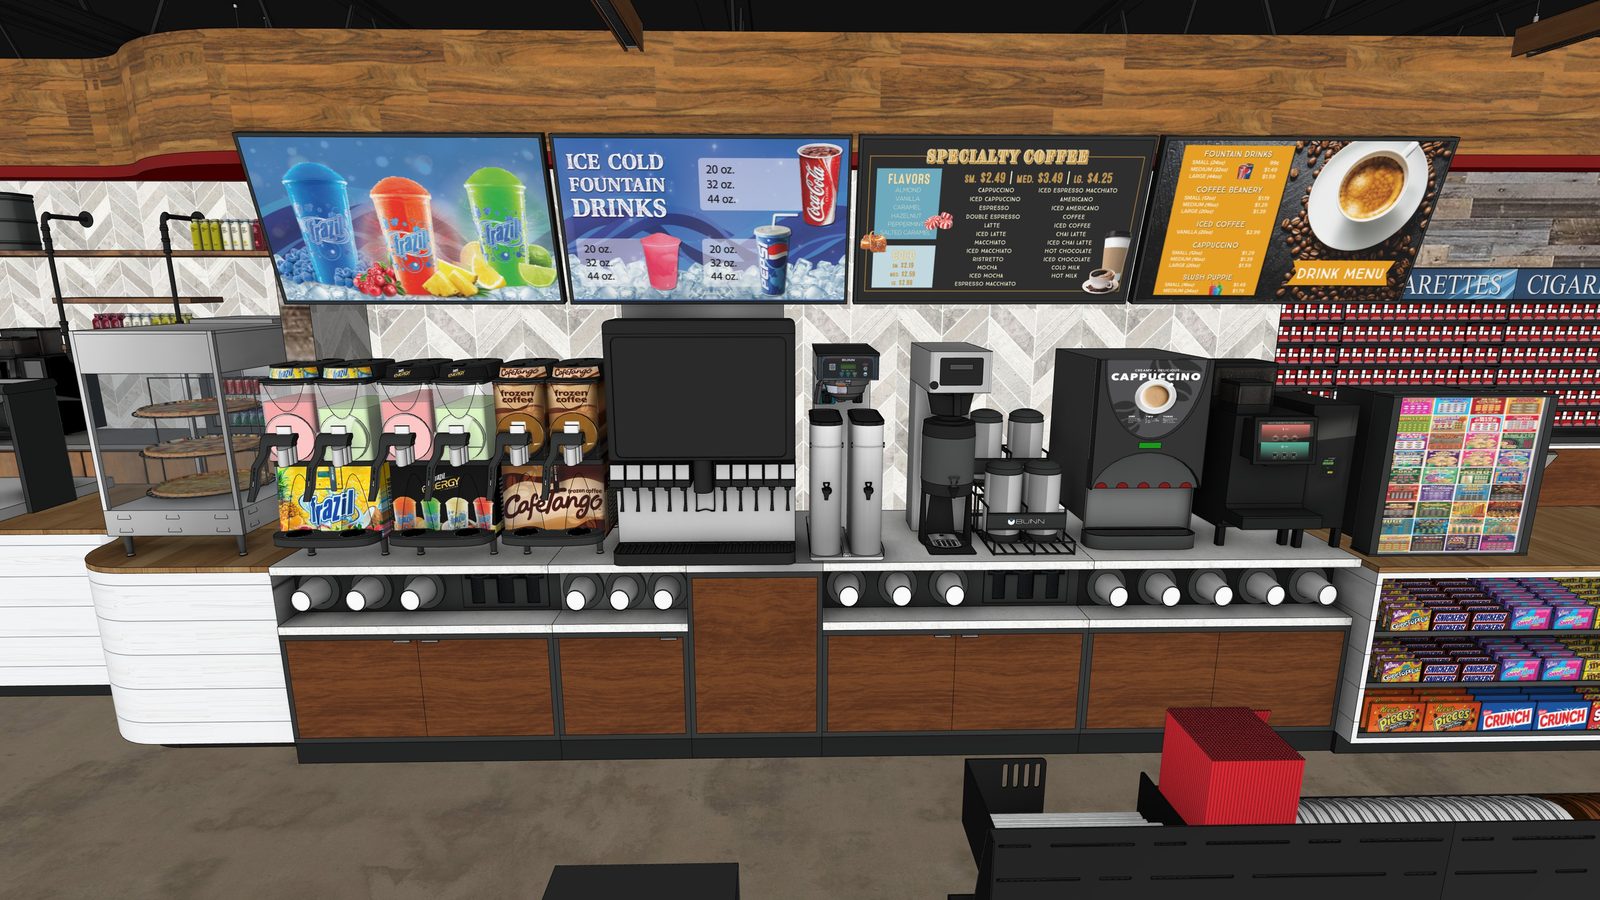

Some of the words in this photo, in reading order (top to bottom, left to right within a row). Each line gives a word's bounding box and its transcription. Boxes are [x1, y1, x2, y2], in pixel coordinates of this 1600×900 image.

[926, 148, 1021, 165] SPECIALTY
[1023, 149, 1090, 165] COFFEE
[566, 153, 601, 170] ICE
[607, 153, 664, 170] COLD
[706, 165, 718, 174] 20
[888, 173, 931, 185] FLAVORS
[964, 174, 977, 184] SM.
[980, 172, 1006, 184] $2.49
[1017, 174, 1034, 184] MED.
[1038, 172, 1063, 184] $3.49
[1073, 174, 1084, 184] LG.
[1087, 172, 1113, 184] $4.25
[569, 177, 665, 193] FOUNTAIN
[707, 180, 718, 190] 32
[721, 182, 735, 190] oz.
[707, 195, 720, 204] 44
[571, 198, 667, 218] DRINKS
[584, 245, 597, 254] 20
[709, 245, 722, 254] 20
[586, 259, 597, 268] 32
[710, 259, 722, 268] 32
[759, 243, 770, 290] PEPSI
[587, 272, 600, 281] 44
[711, 272, 723, 281] 44
[1296, 267, 1340, 280] DRINK
[1343, 267, 1385, 281] MENU
[1527, 274, 1600, 295] CIGAR
[1111, 372, 1201, 381] CAPPUCCINO
[500, 389, 534, 398] frozen
[554, 389, 588, 398] frozen
[502, 396, 534, 404] coffee
[556, 396, 588, 404] coffee
[310, 488, 355, 526] frazil
[1435, 613, 1468, 622] SNICKERS
[1474, 613, 1507, 622] SNICKERS
[1425, 665, 1458, 673] SNICKERS
[1463, 665, 1496, 673] SNICKERS
[1378, 709, 1416, 731] Pieces
[1434, 709, 1471, 731] Pieces
[1485, 709, 1530, 728] CRUNCH
[1539, 709, 1586, 727] CRUNCH
